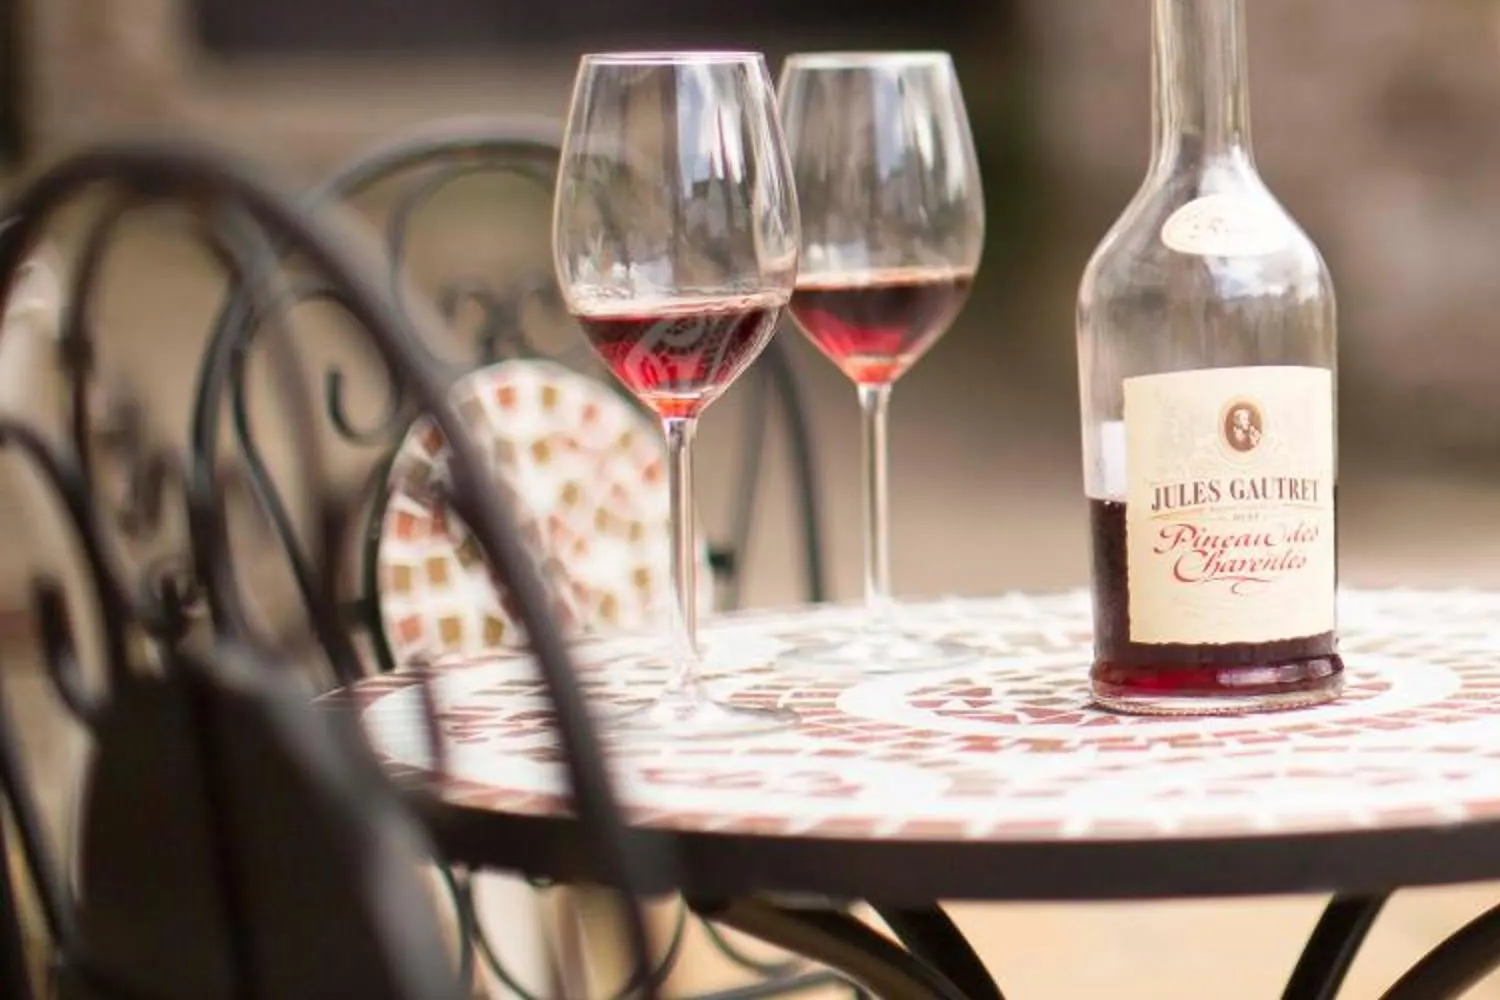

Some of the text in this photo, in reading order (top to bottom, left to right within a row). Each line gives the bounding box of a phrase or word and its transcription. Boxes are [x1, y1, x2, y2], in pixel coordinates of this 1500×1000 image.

[1151, 476, 1320, 512] JULES GAUTRET
[1173, 548, 1308, 583] Charentes
